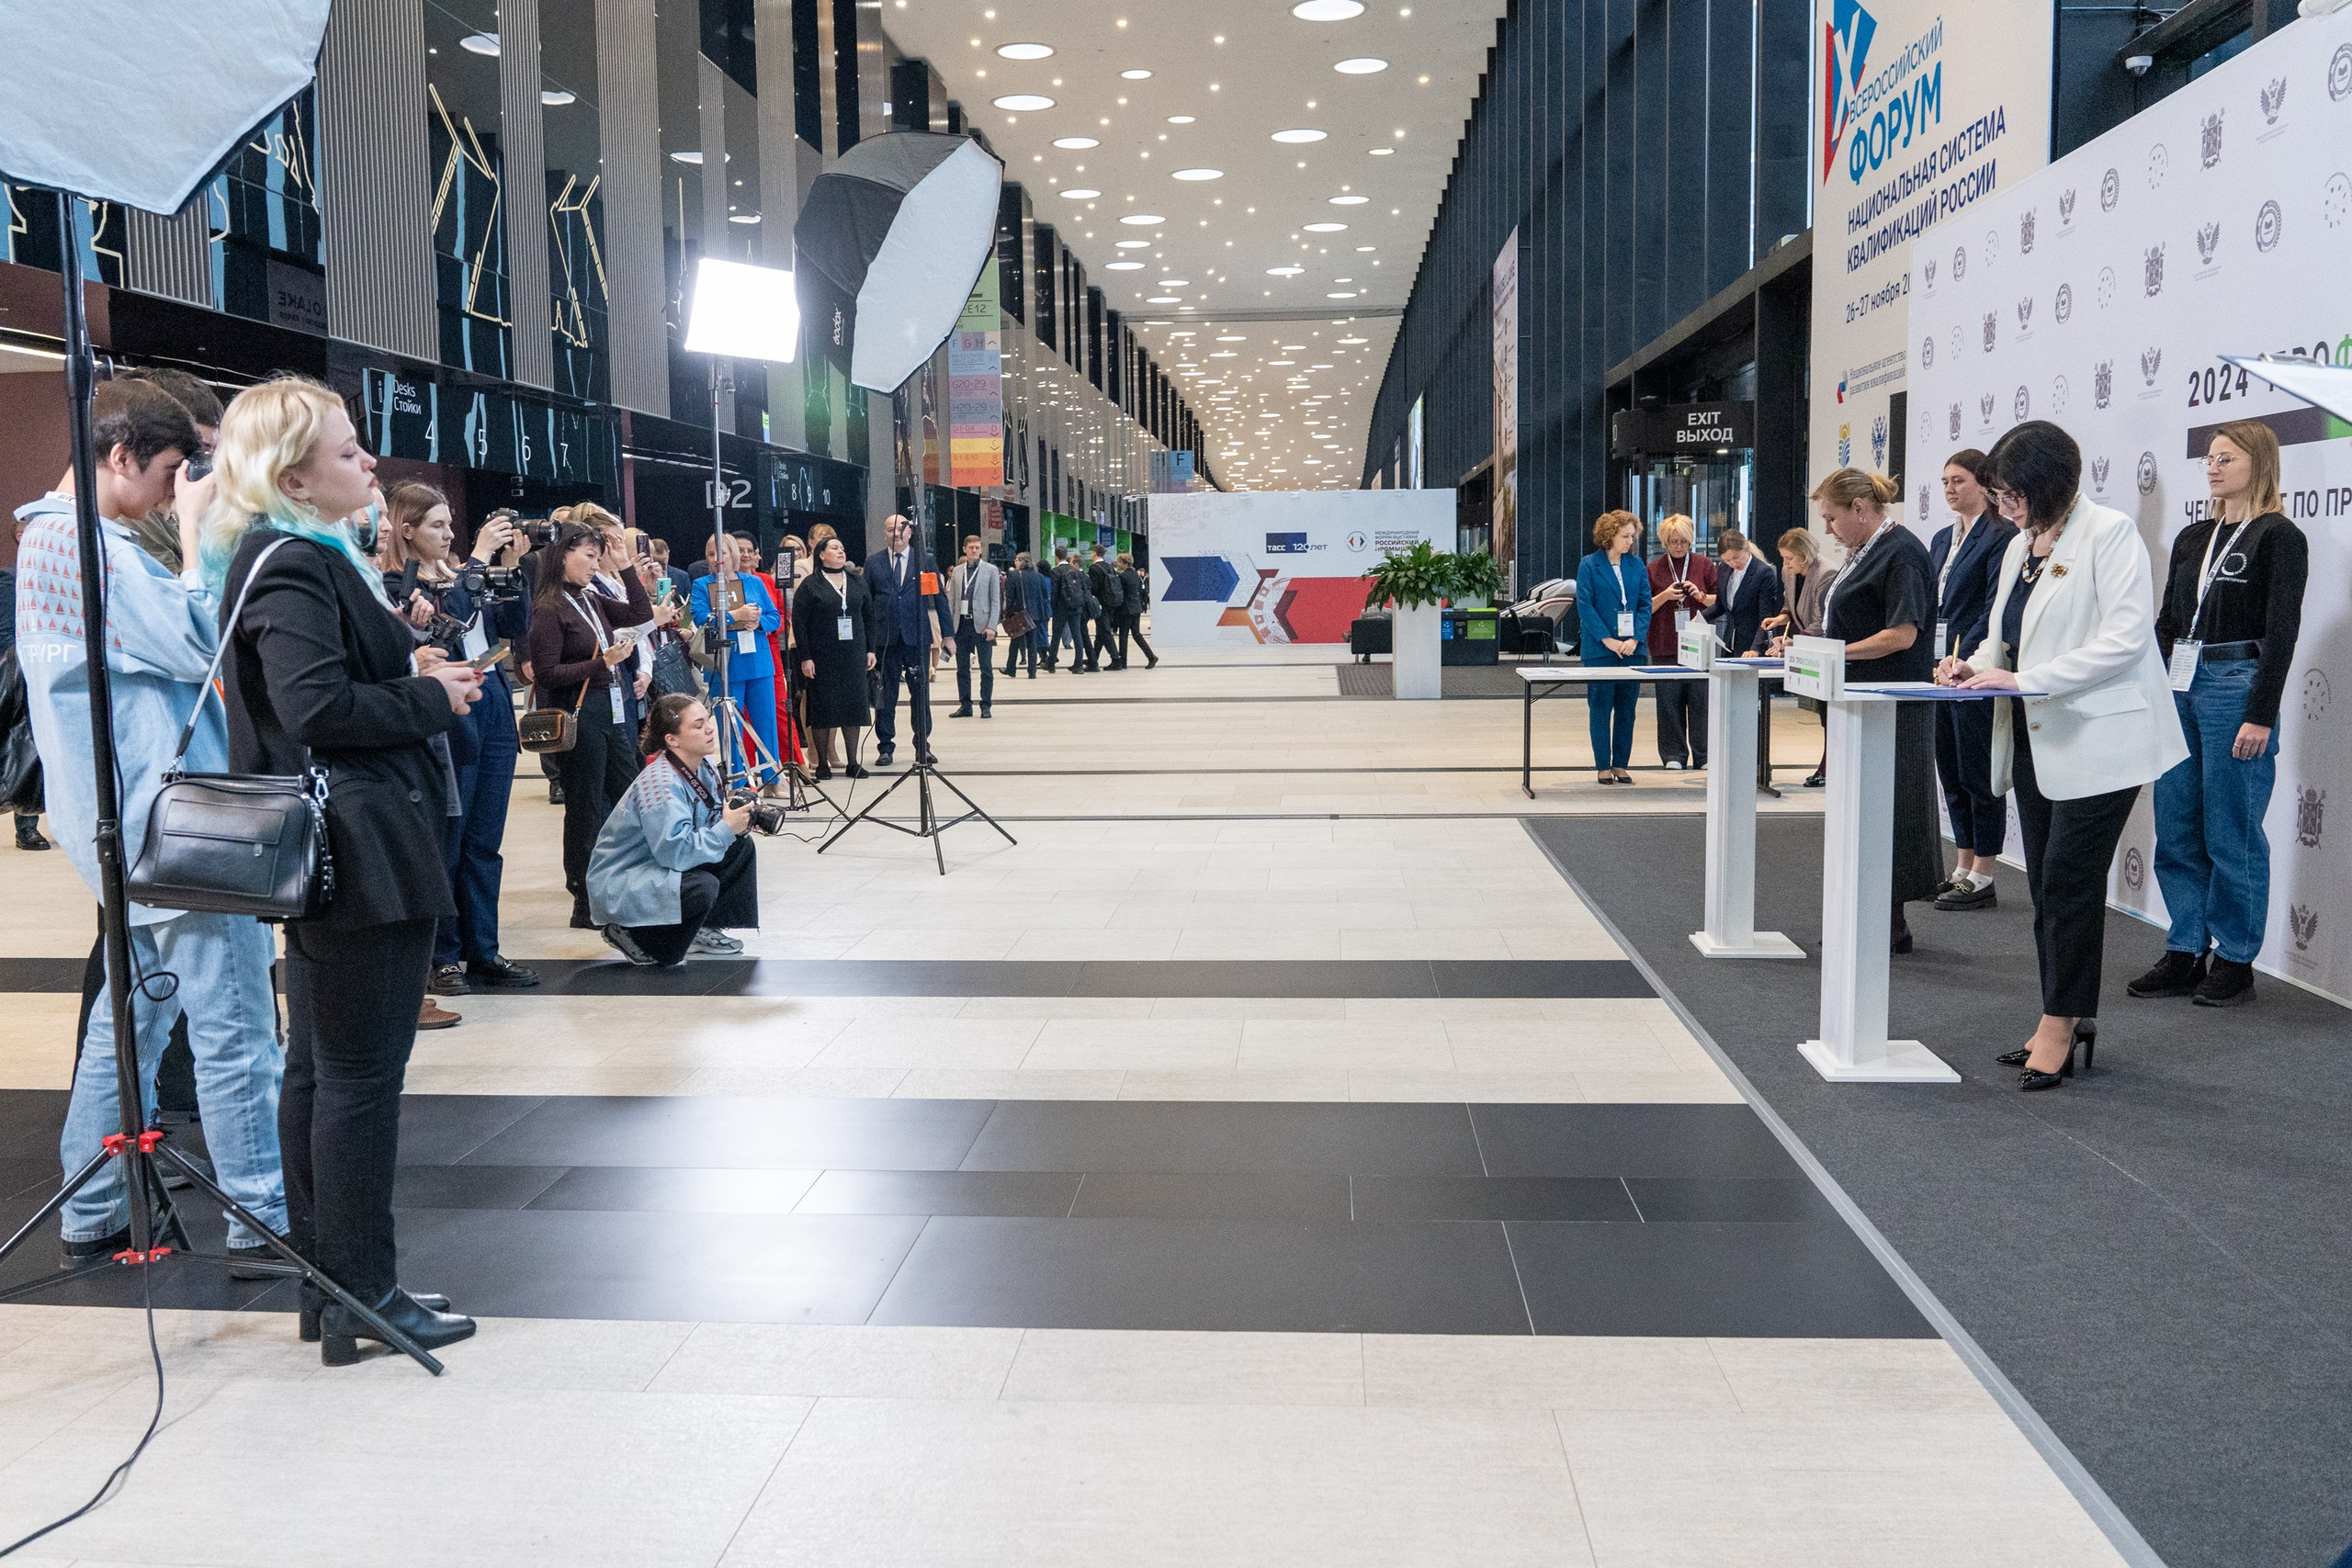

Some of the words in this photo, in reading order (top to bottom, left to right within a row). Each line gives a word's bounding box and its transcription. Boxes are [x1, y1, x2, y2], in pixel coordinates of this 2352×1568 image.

[1849, 15, 1943, 124] ВСЕРОССИЙСКИЙ
[1849, 61, 1941, 186] ФОРУМ
[1848, 151, 1937, 235] НАЦИОНАЛЬНАЯ
[1939, 105, 2006, 174] СИСТЕМА
[1848, 188, 1937, 274] КВАЛИФИКАЦИЙ
[1940, 158, 1996, 219] РОССИИ
[1871, 281, 1900, 310] ноября
[952, 339, 957, 348] F
[965, 339, 971, 348] G
[976, 338, 983, 347] H
[393, 379, 416, 398] Desks
[2188, 364, 2248, 408] 2024
[393, 396, 422, 415] Стойки
[1688, 412, 1721, 426] EXIT
[424, 420, 435, 447] 4
[478, 428, 488, 455] 5
[522, 436, 531, 461] 6
[560, 443, 569, 467] 7
[1677, 427, 1734, 443] ВЫХОД
[1177, 453, 1185, 466] F
[791, 483, 797, 501] 8
[823, 489, 831, 505] 10
[2293, 490, 2319, 519] ПО
[696, 785, 708, 799] EOS
